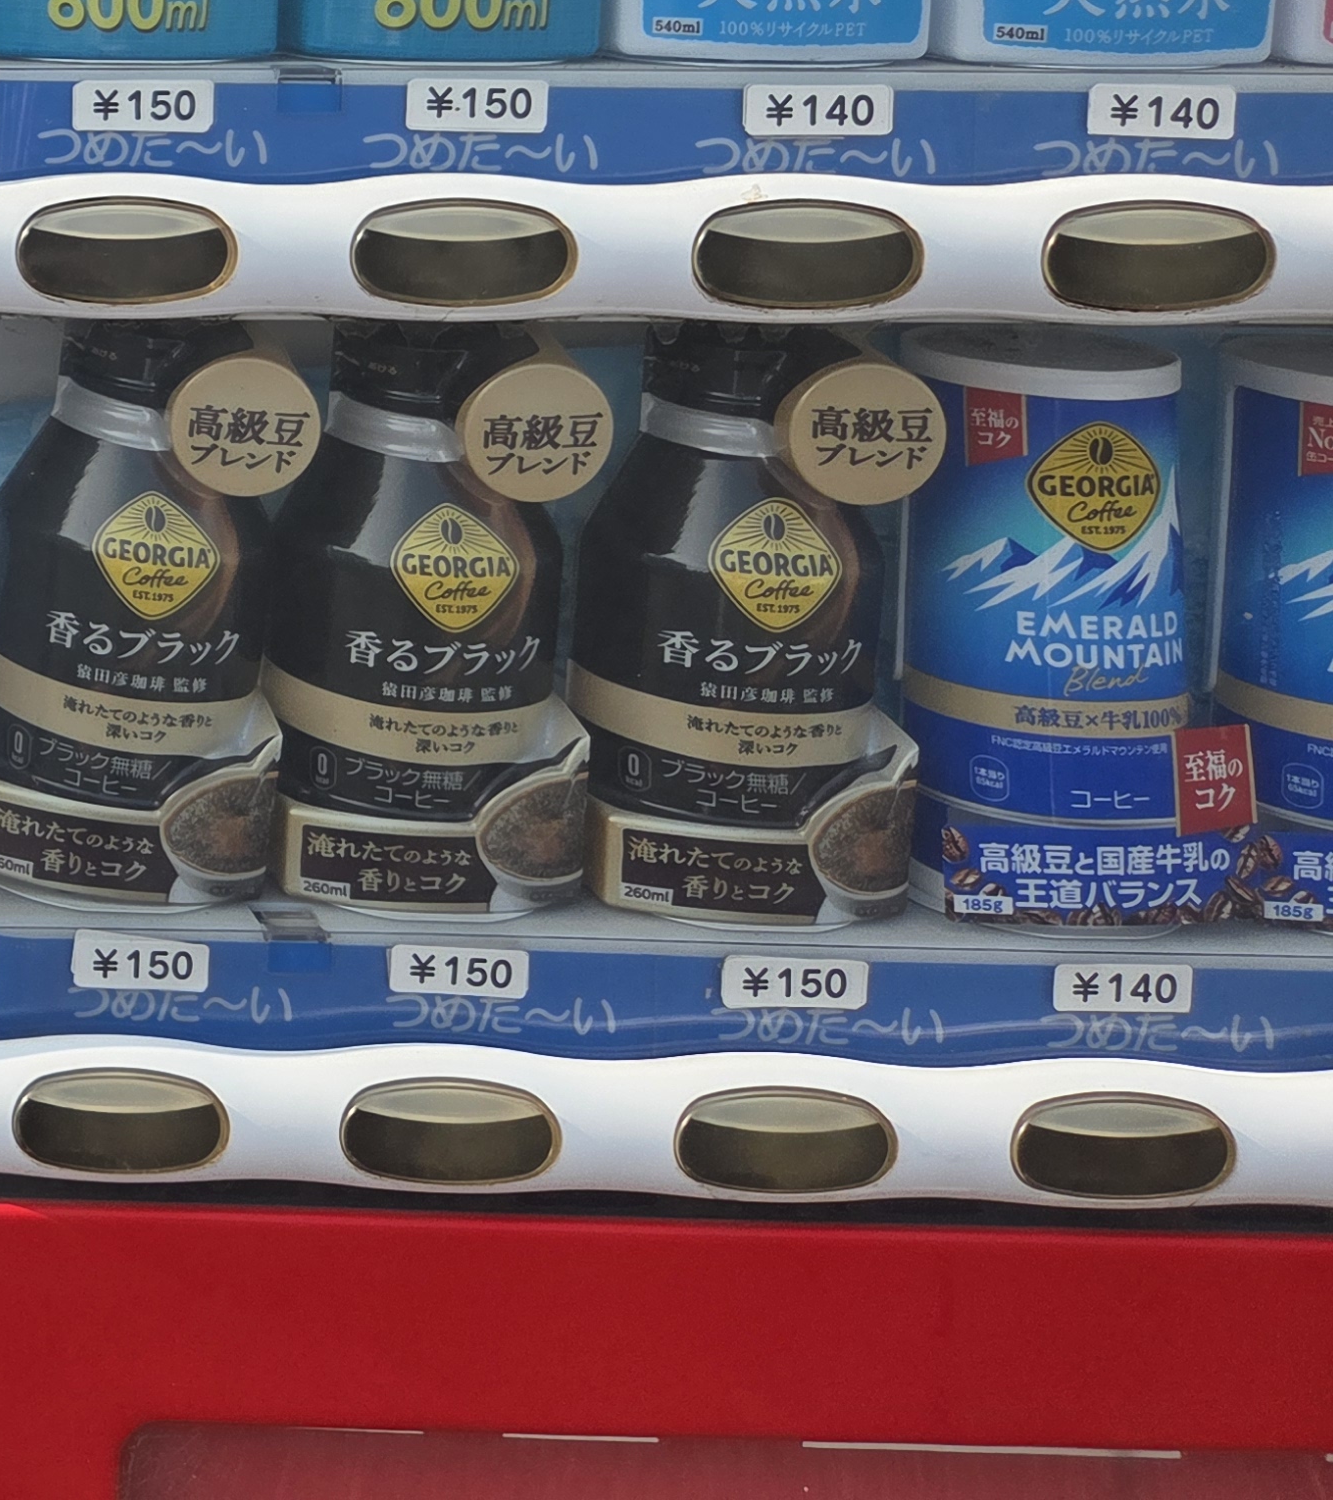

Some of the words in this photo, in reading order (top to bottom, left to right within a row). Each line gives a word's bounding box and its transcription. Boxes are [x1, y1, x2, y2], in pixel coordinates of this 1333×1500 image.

[654, 19, 701, 35] 540ml
[719, 21, 866, 38] 100%リサイクルPET
[995, 26, 1046, 42] 540ml
[1064, 28, 1214, 45] 100%リサイクルPET
[93, 89, 196, 122] ¥150
[426, 87, 533, 119] ¥150
[766, 94, 874, 127] ¥140
[1110, 95, 1220, 130] ¥140
[189, 405, 310, 448] 高級豆
[483, 412, 603, 450] 高級豆
[811, 405, 934, 444] 高級豆
[970, 407, 1019, 430] 至福の
[978, 431, 1013, 449] コク
[190, 443, 297, 474] ブレンド
[486, 451, 592, 476] ブレンド
[815, 443, 928, 470] ブレンド
[1037, 473, 1156, 498] GEORGIA
[1067, 501, 1137, 523] Coffee
[103, 537, 211, 569] GEORGIA
[401, 553, 512, 579] GEORGIA
[719, 549, 834, 577] GEORGIA
[122, 566, 189, 588] Coffee
[424, 580, 492, 602] Coffee
[744, 579, 814, 600] Coffee
[46, 610, 241, 666] 香るブラック
[1016, 610, 1178, 641] EMERALD
[344, 630, 541, 677] 香るブラック
[657, 630, 863, 677] 香るブラック
[1005, 637, 1183, 670] MOUNTAIN
[1063, 664, 1149, 696] Blend
[63, 694, 212, 729] 淹れたてのような香りと
[368, 713, 519, 737] 淹れたてのような香りと
[105, 724, 167, 743] 深いコク
[415, 737, 475, 754] 深いコク
[1184, 749, 1243, 783] 至福の
[63, 767, 138, 795] コーヒー
[373, 785, 450, 810] コーヒー
[1194, 784, 1236, 812] コク
[307, 831, 472, 867] 淹れたてのような
[978, 842, 1231, 875] 高級豆と国産牛乳の
[40, 847, 147, 883] 香りとコク
[303, 879, 347, 898] 260ml
[357, 866, 467, 894] 香りとコク
[1015, 878, 1203, 910] 王道バランス
[962, 898, 1004, 914] 185g
[1273, 903, 1314, 919] 185g
[93, 948, 193, 980] ¥150
[409, 953, 513, 989] ¥150
[743, 967, 847, 999] ¥150
[1072, 972, 1178, 1004] ¥140
